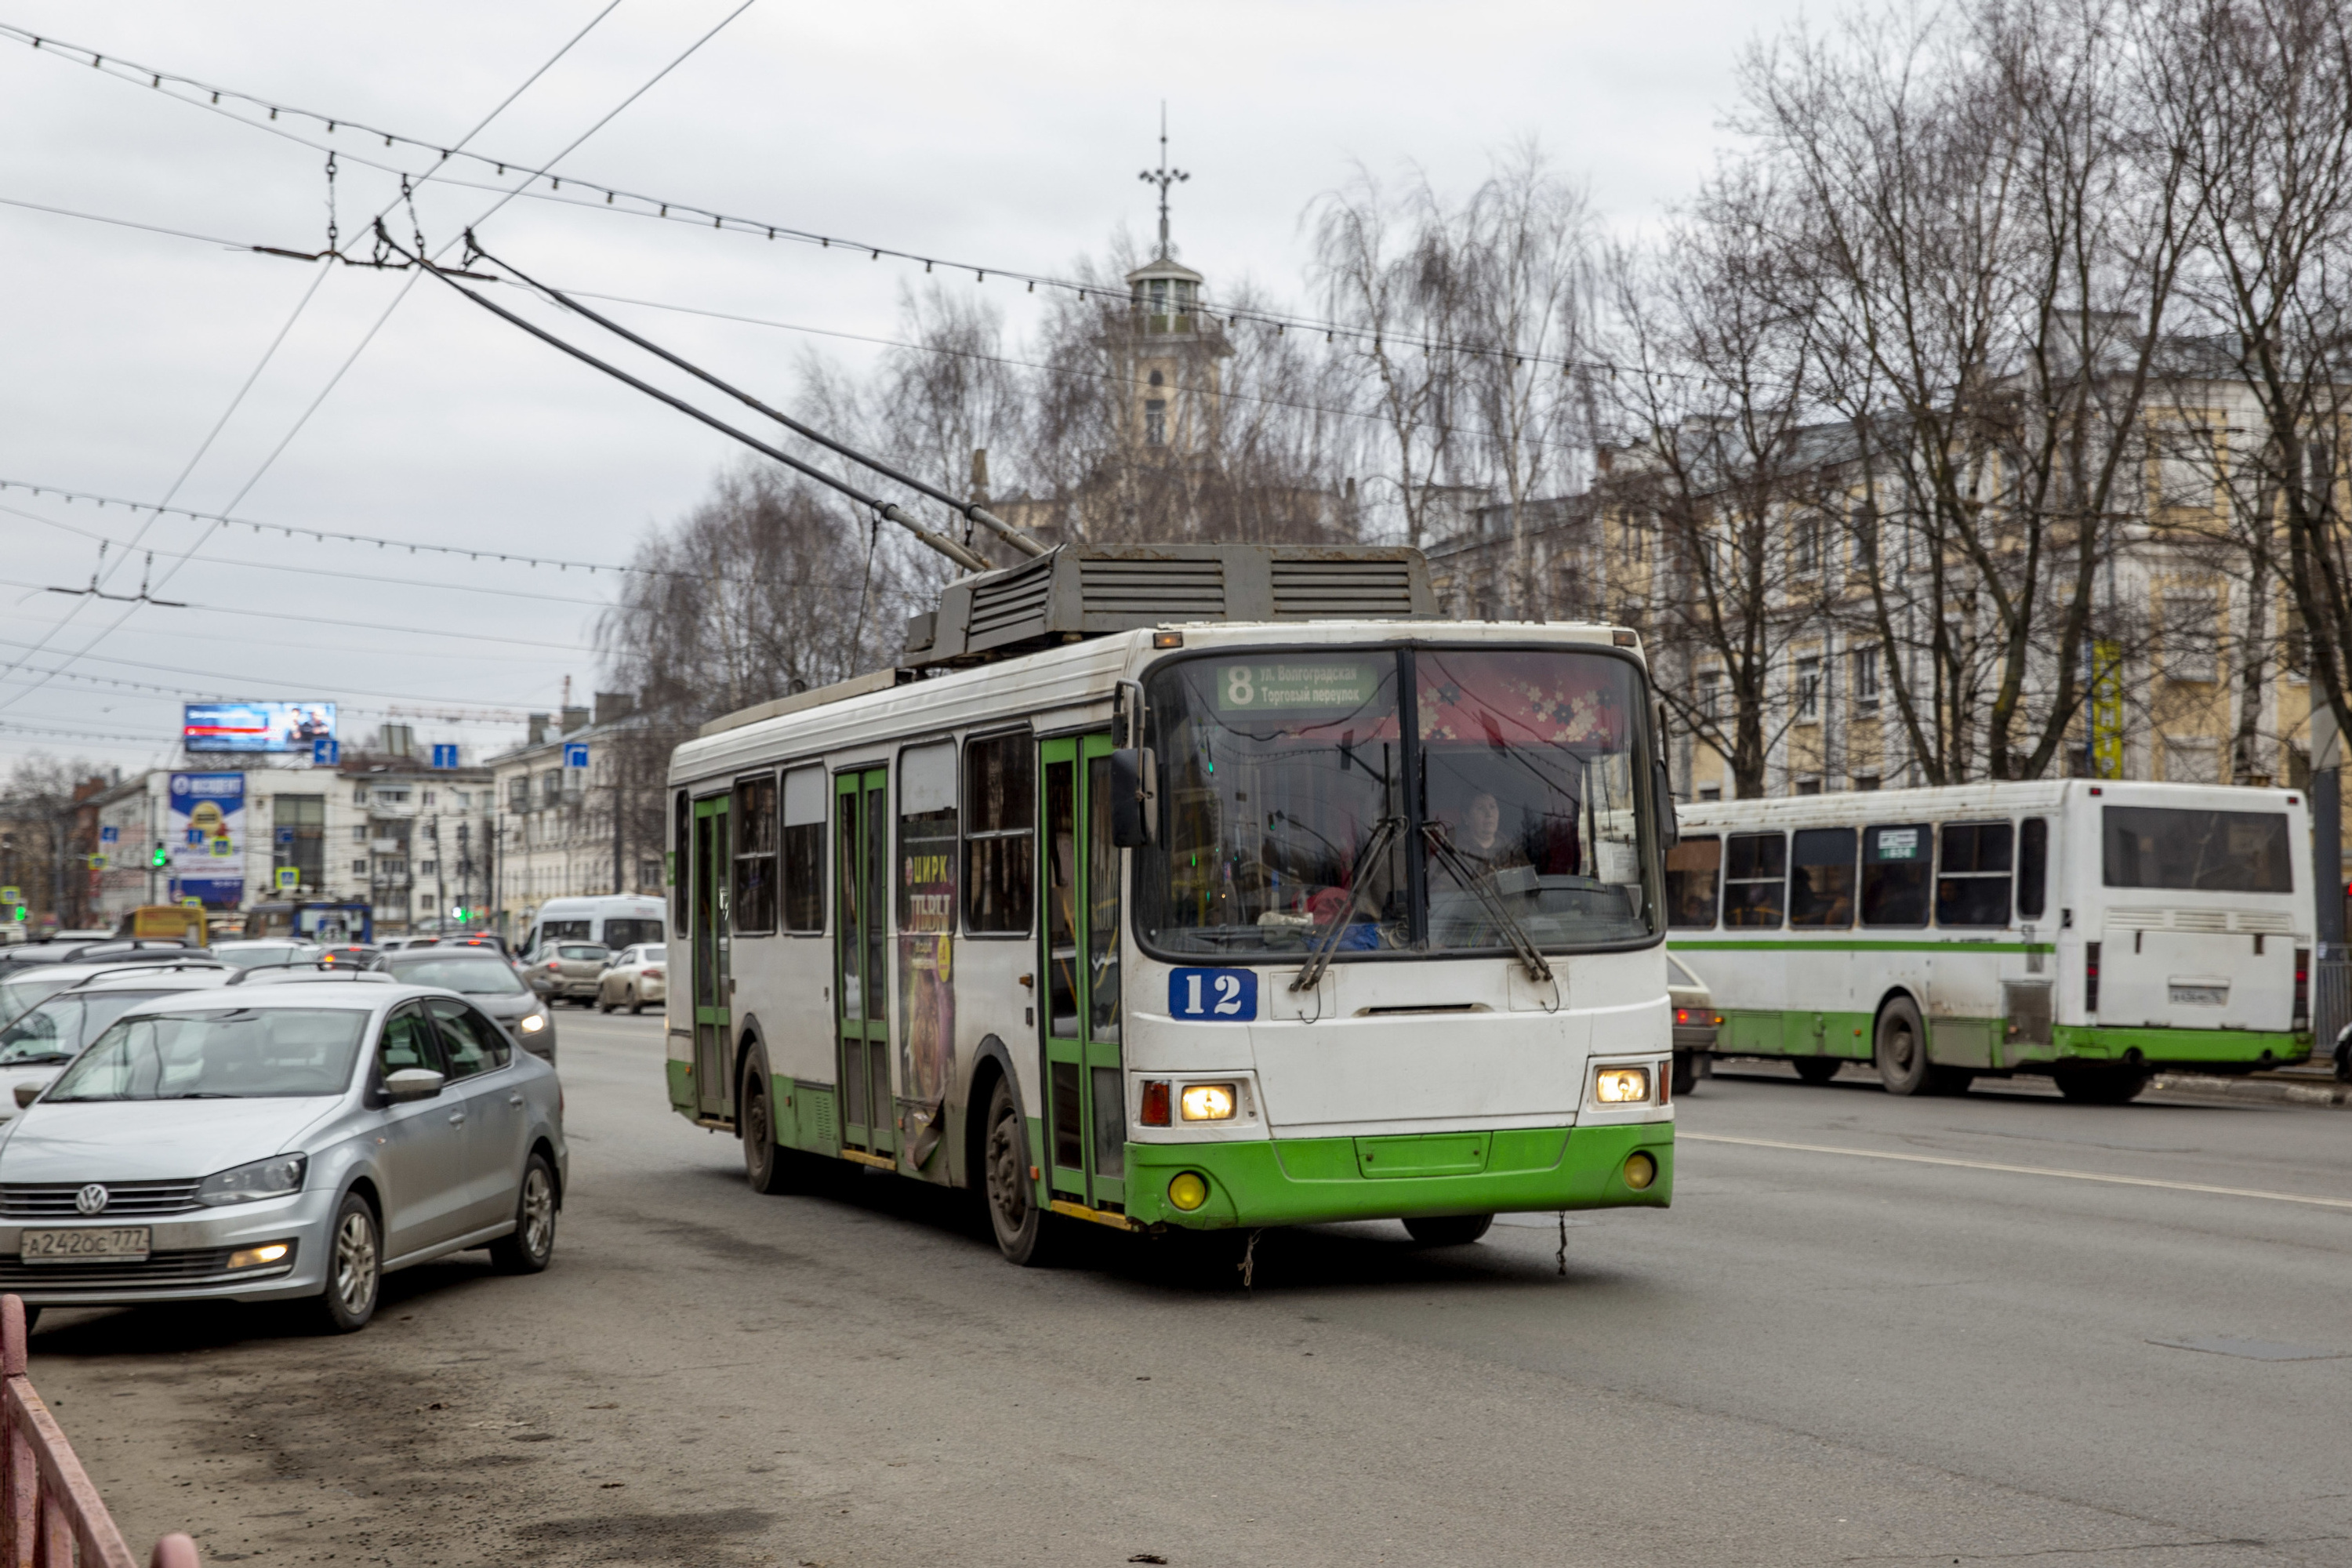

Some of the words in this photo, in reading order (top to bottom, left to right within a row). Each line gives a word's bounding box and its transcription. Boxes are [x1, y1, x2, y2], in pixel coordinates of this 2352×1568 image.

[1228, 666, 1254, 705] 8
[1261, 666, 1275, 682] ул.
[1278, 666, 1357, 684] Волгоградская
[1261, 687, 1310, 706] Торговый
[1312, 688, 1359, 704] переулок
[913, 855, 948, 884] ЦИРК
[909, 895, 950, 933] ЛЬВЫ
[1185, 975, 1242, 1015] 12
[112, 1230, 143, 1246] 777
